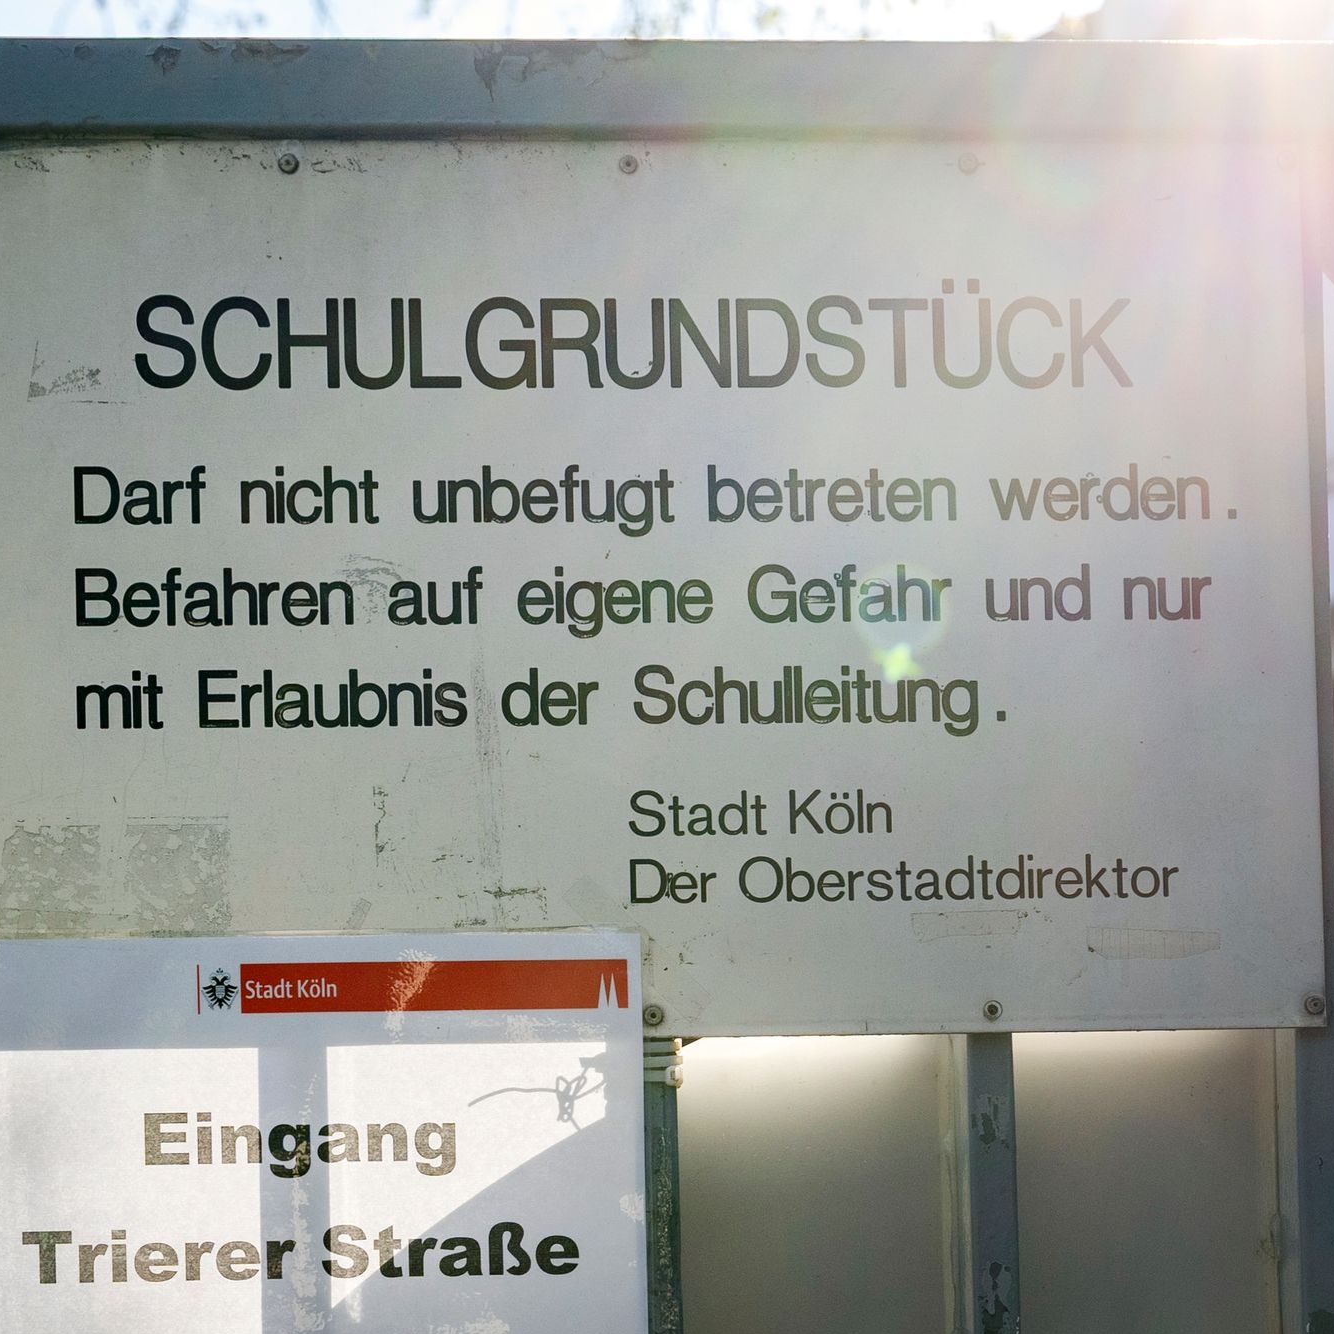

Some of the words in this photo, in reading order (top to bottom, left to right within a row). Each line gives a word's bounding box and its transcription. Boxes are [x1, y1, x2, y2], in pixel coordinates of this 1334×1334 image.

[133, 278, 1134, 391] SCHULGRUNDSTÜCK
[73, 464, 207, 525] Darf
[240, 464, 380, 524] nicht
[412, 463, 676, 538] unbefugt
[707, 464, 958, 523] betreten
[988, 462, 1238, 521] werden.
[74, 566, 354, 628] Befahren
[387, 565, 483, 626] auf
[516, 565, 714, 639] eigene
[746, 563, 952, 623] Gefahr
[984, 563, 1091, 622] und
[1123, 575, 1212, 621] nur
[75, 670, 164, 729] mit
[197, 668, 468, 728] Erlaubnis
[500, 666, 599, 726] der
[632, 663, 1007, 738] Schulleitung.
[627, 789, 768, 838] Stadt
[789, 788, 893, 835] Köln
[627, 857, 717, 905] Der
[737, 853, 1179, 903] Oberstadtdirektor
[244, 978, 293, 1000] Stadt
[297, 976, 338, 999] Köln
[142, 1110, 457, 1179] Eingang
[21, 1228, 296, 1285] Trierer
[321, 1220, 580, 1280] Straße
